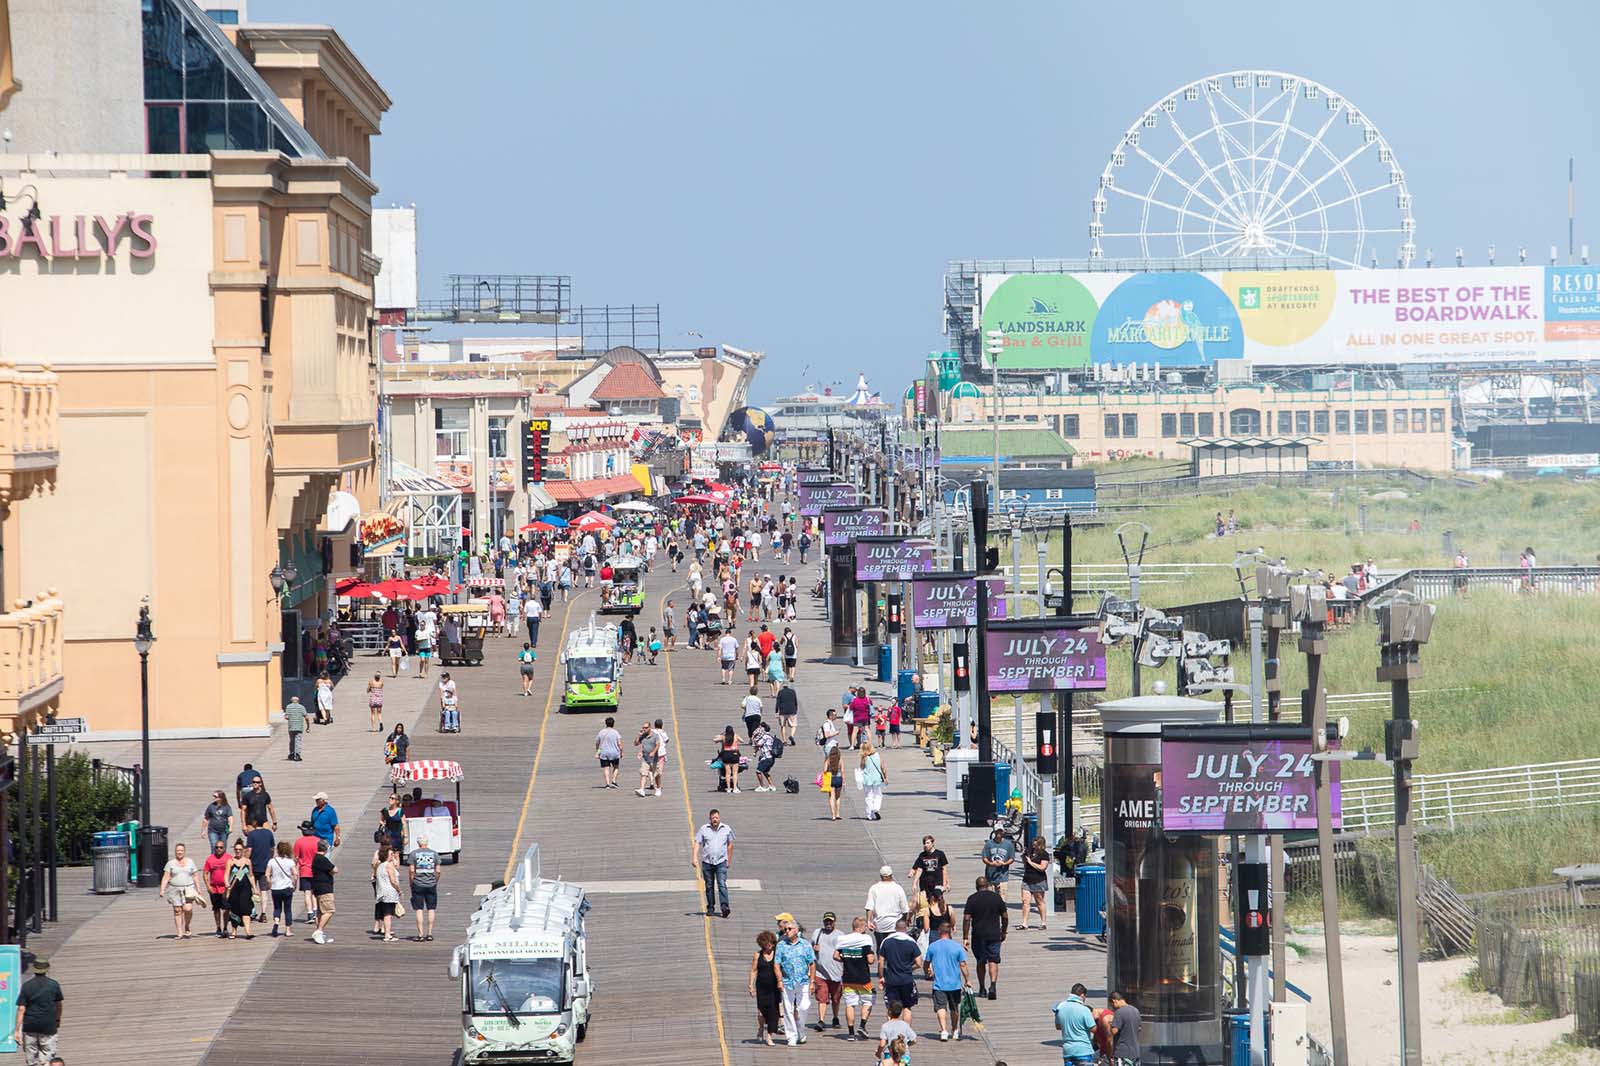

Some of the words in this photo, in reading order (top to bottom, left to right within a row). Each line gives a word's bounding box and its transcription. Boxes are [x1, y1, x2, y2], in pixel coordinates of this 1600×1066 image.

[0, 211, 157, 257] BALLY'S
[1350, 288, 1390, 304] THE
[1397, 287, 1449, 303] BEST
[1456, 286, 1484, 302] OF
[1490, 285, 1531, 301] THE
[1395, 304, 1538, 322] BOARDWALK.
[998, 320, 1086, 333] LANDSHARK
[1002, 337, 1027, 347] Bar
[1031, 336, 1043, 347] &
[1046, 335, 1082, 347] Grill
[1346, 333, 1376, 346] ALL
[1380, 333, 1396, 345] IN
[1401, 333, 1434, 345] ONE
[1439, 332, 1489, 344] GREAT
[1494, 331, 1538, 343] SPOT.
[547, 456, 569, 465] ECK
[808, 490, 834, 499] JULY
[836, 490, 848, 499] 24
[834, 515, 863, 525] JULY
[866, 515, 880, 525] 24
[867, 547, 901, 558] JULY
[904, 547, 920, 558] 24
[864, 564, 918, 573] SEPTEMBER
[927, 586, 968, 600] JULY
[923, 607, 975, 618] SEPTEMB
[1003, 638, 1057, 656] JULY
[1062, 638, 1088, 654] 24
[1024, 657, 1067, 665] THROUGH
[998, 665, 1085, 679] SEPTEMBER
[1089, 665, 1096, 677] 1
[1187, 753, 1268, 779] JULY
[1275, 753, 1314, 778] 24
[1218, 781, 1283, 793] THROUGH
[1178, 794, 1309, 814] SEPTEMBER
